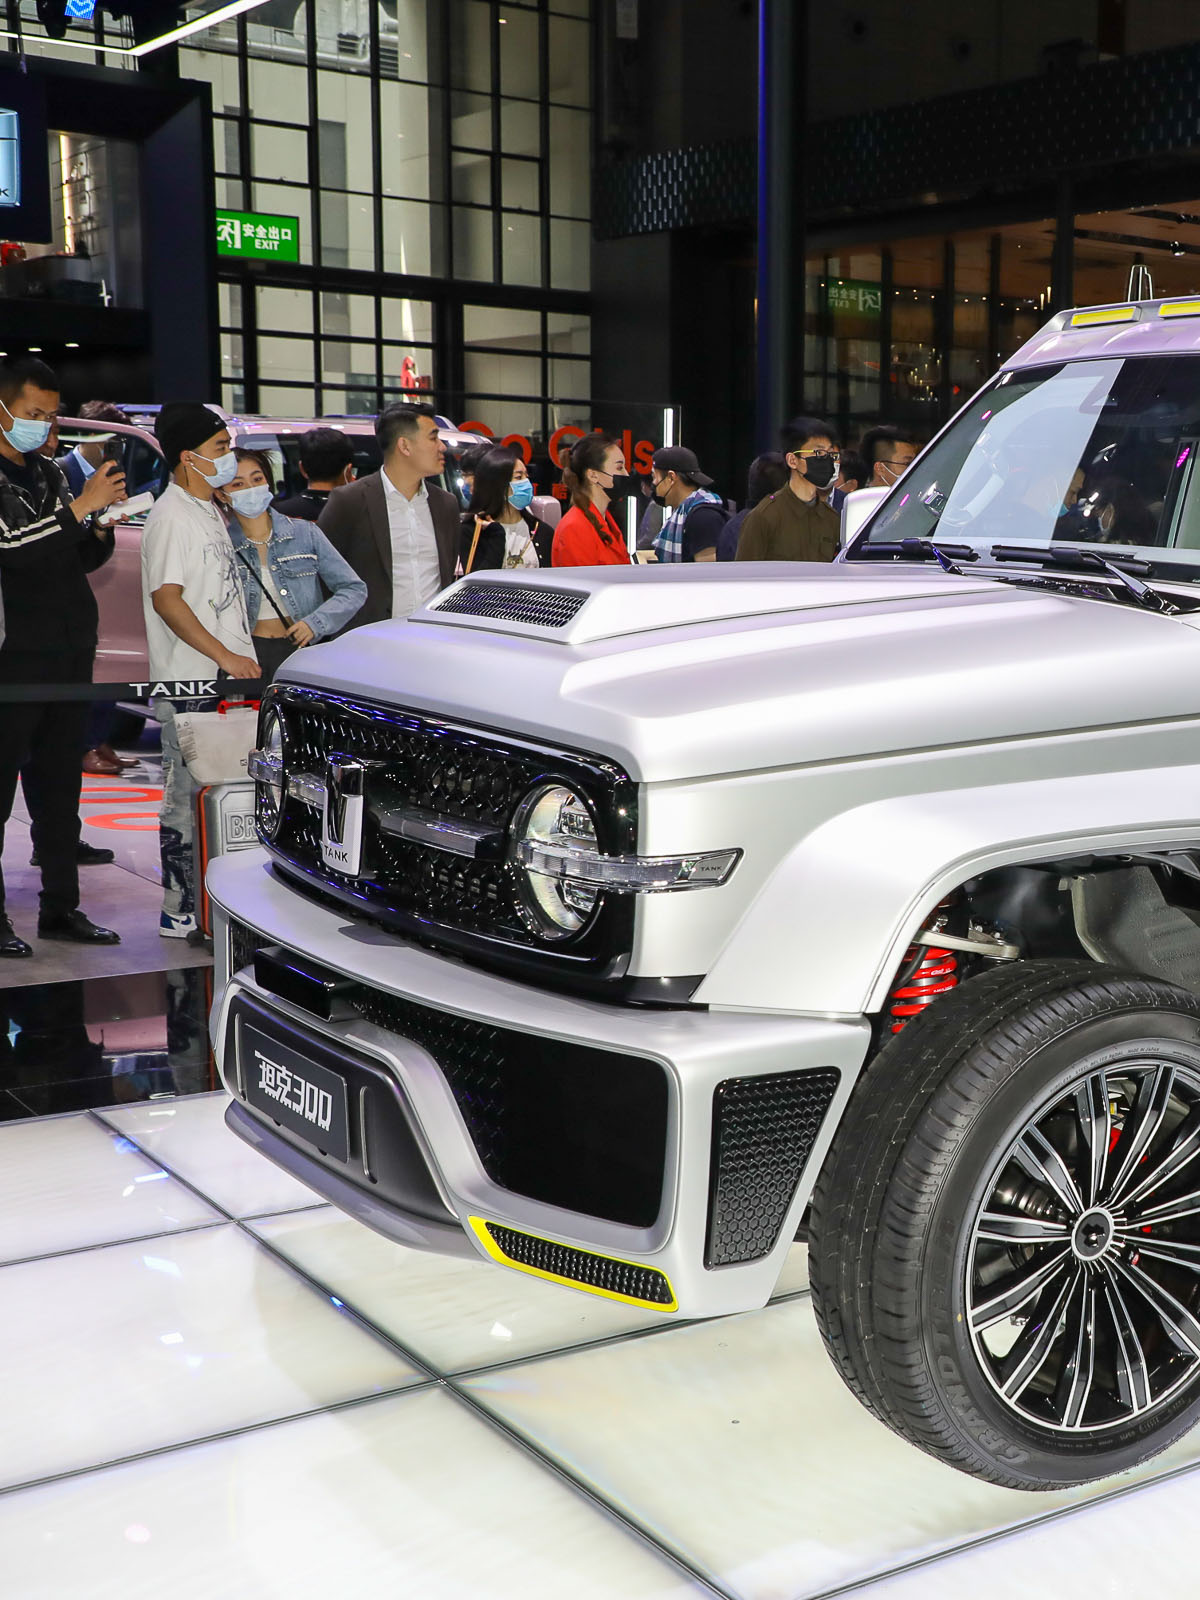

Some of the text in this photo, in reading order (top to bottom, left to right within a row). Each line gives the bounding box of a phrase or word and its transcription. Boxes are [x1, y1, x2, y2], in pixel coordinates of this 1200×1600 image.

[242, 223, 292, 240] 安全出口
[255, 239, 279, 250] EXIT
[129, 681, 217, 696] TANK
[324, 845, 348, 863] TANK
